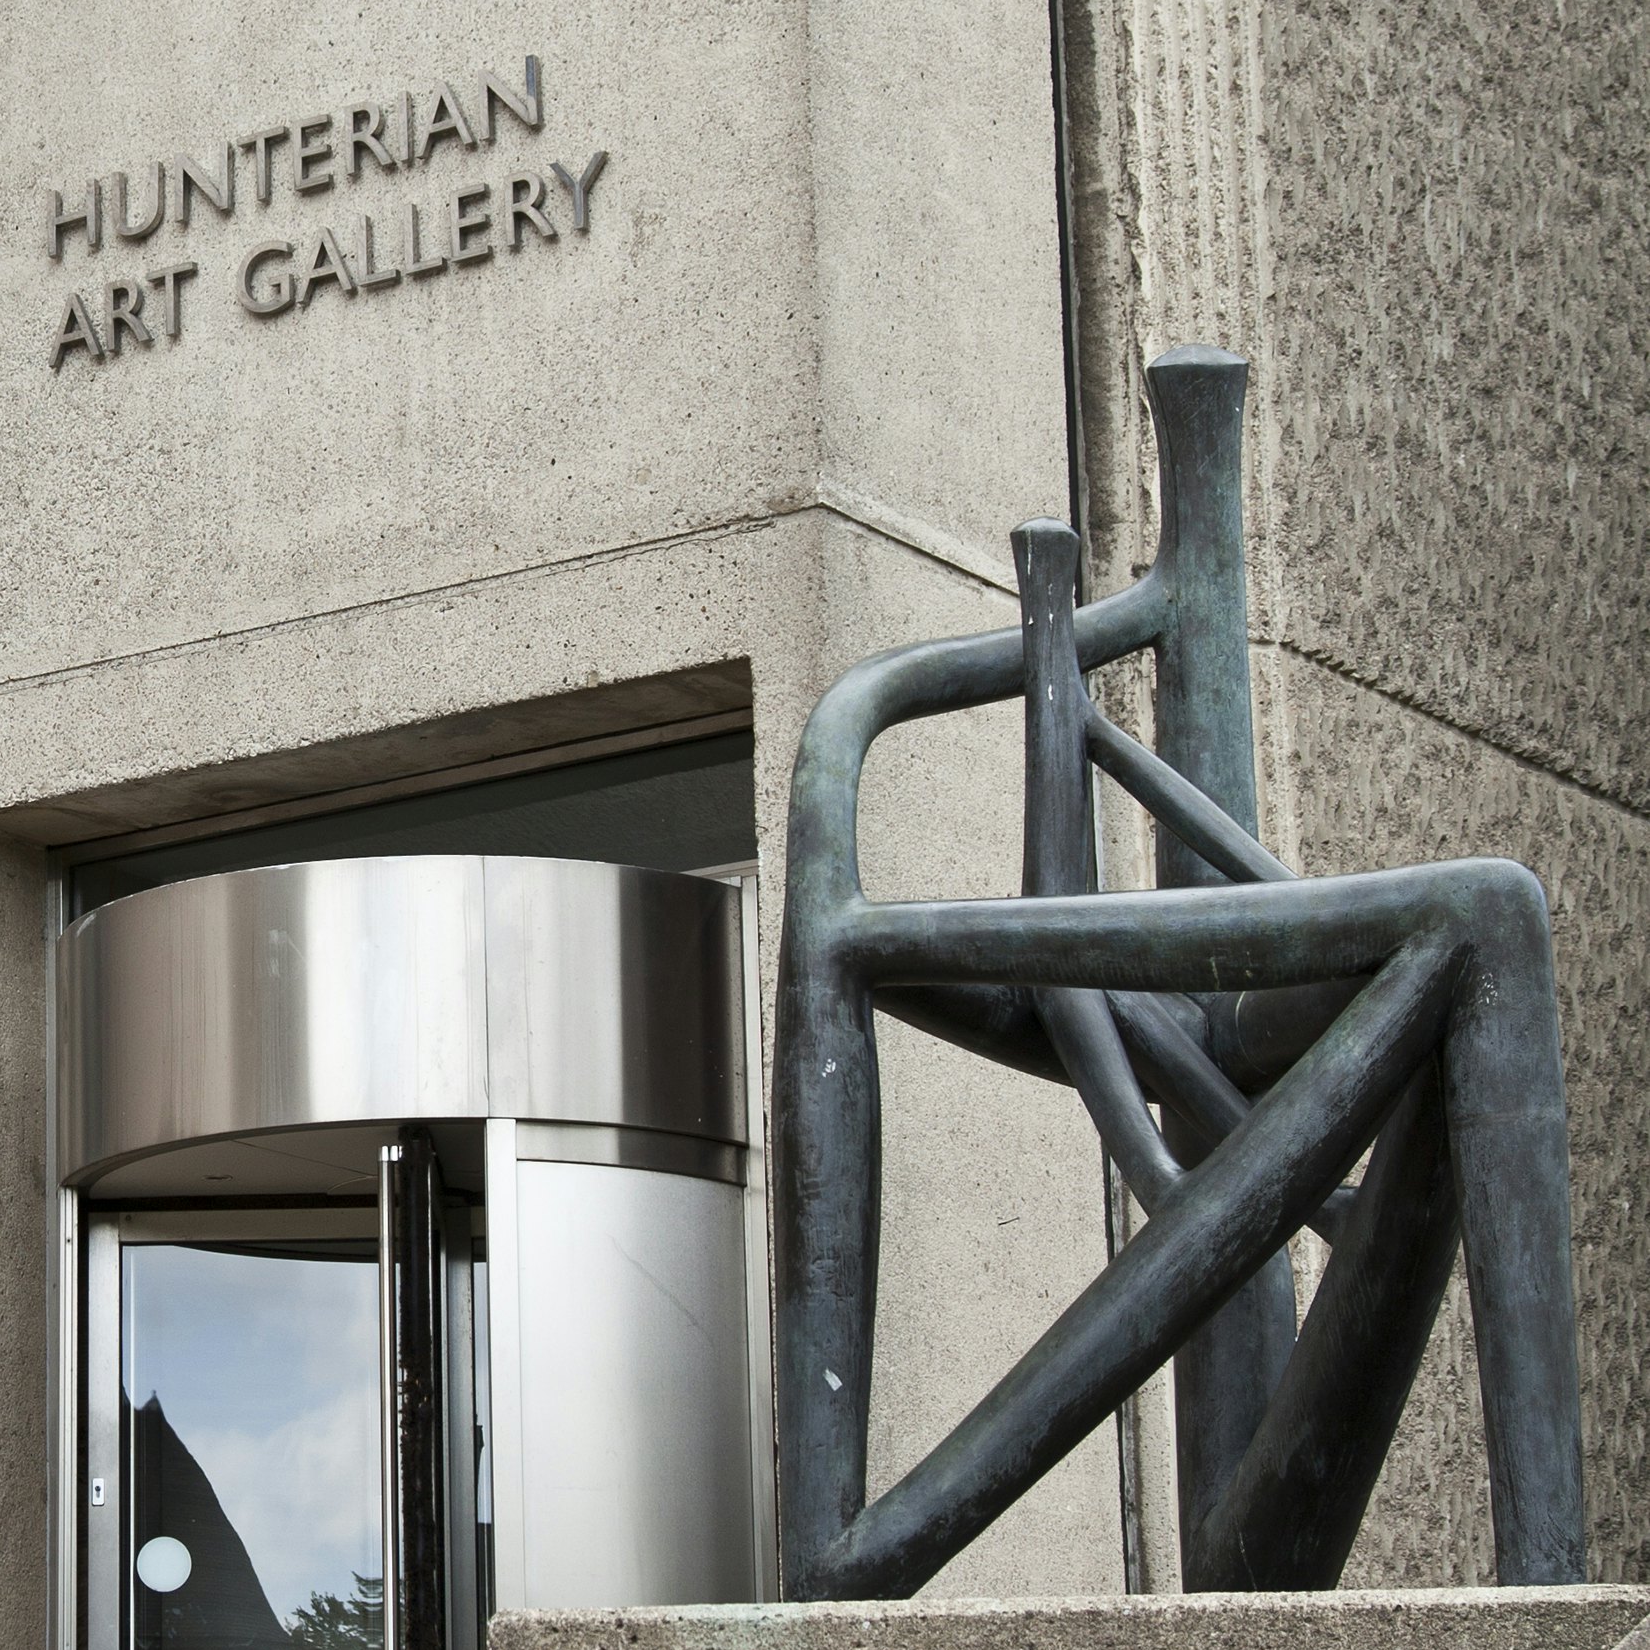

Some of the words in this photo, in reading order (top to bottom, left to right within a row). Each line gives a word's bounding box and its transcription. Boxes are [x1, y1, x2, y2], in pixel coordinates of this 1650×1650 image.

[48, 53, 543, 260] HUNTERIAN
[48, 261, 198, 372] ART
[236, 150, 609, 317] GALLERY
